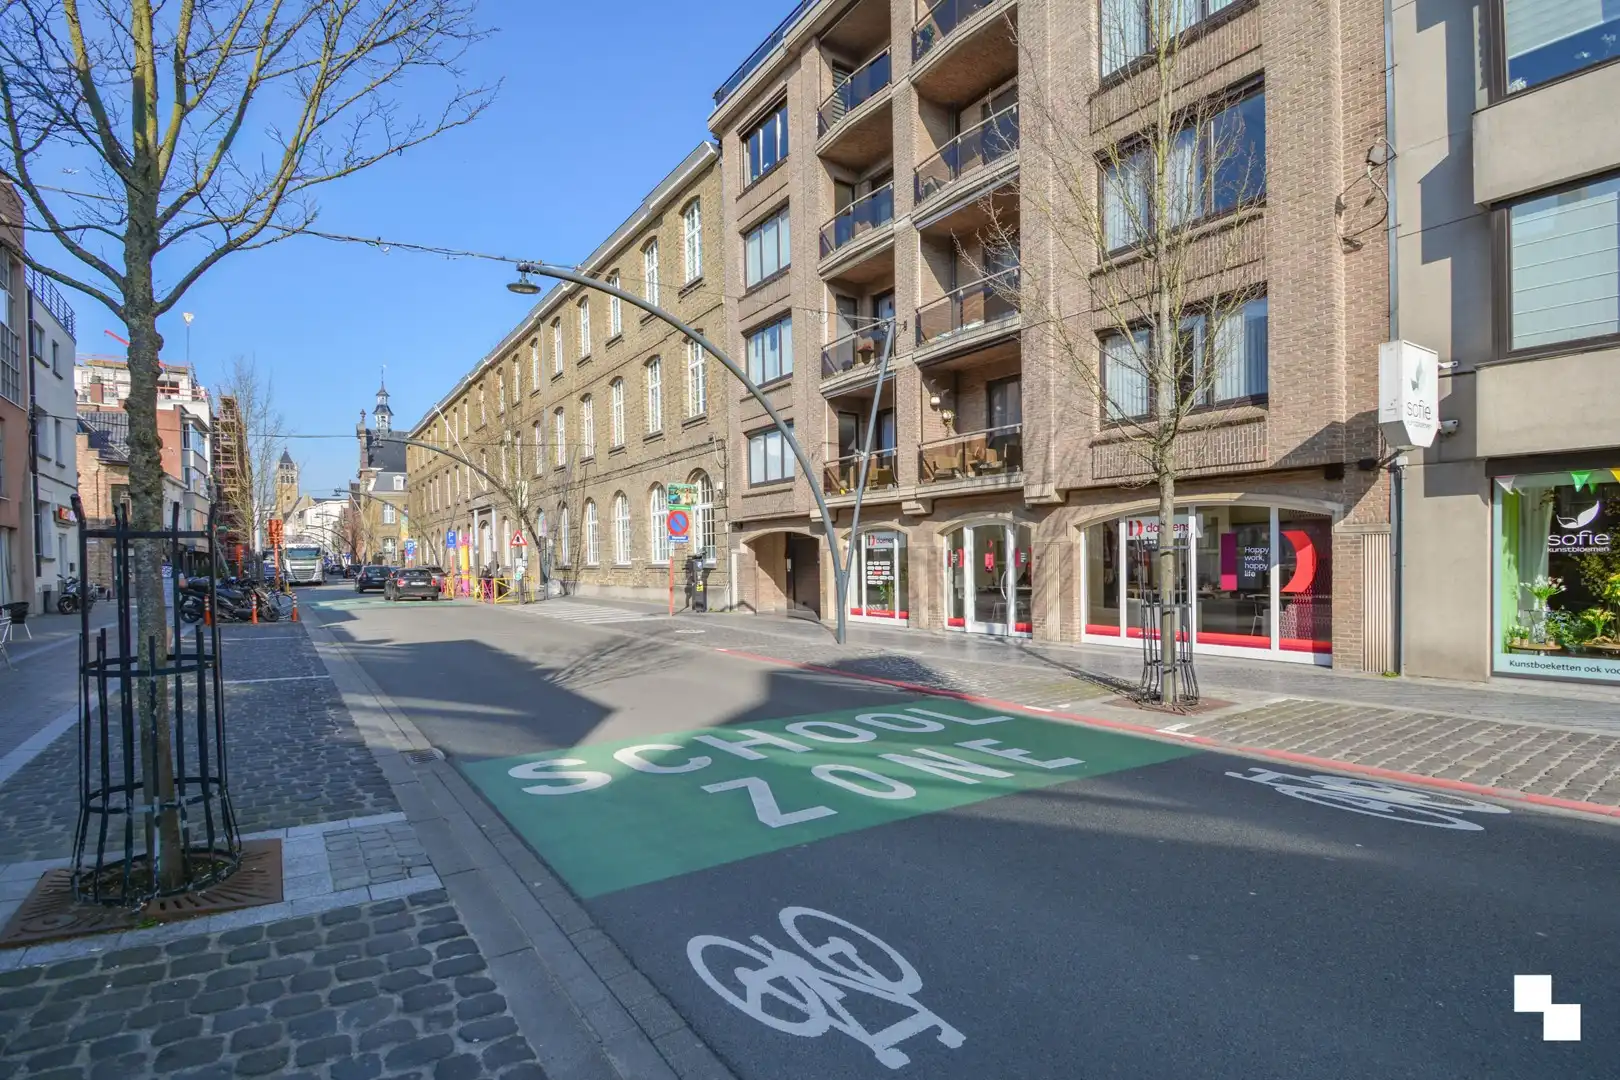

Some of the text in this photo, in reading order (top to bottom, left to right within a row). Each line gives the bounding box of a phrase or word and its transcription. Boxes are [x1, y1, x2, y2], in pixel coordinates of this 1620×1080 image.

[1406, 399, 1431, 420] sofie
[1547, 530, 1610, 546] sofie
[1244, 546, 1269, 555] Happy
[1244, 562, 1269, 571] happy
[1509, 659, 1581, 672] Kunstboeketten
[1584, 665, 1602, 673] ook
[508, 708, 1015, 796] SCHOOL
[701, 738, 1085, 828] ZONE
